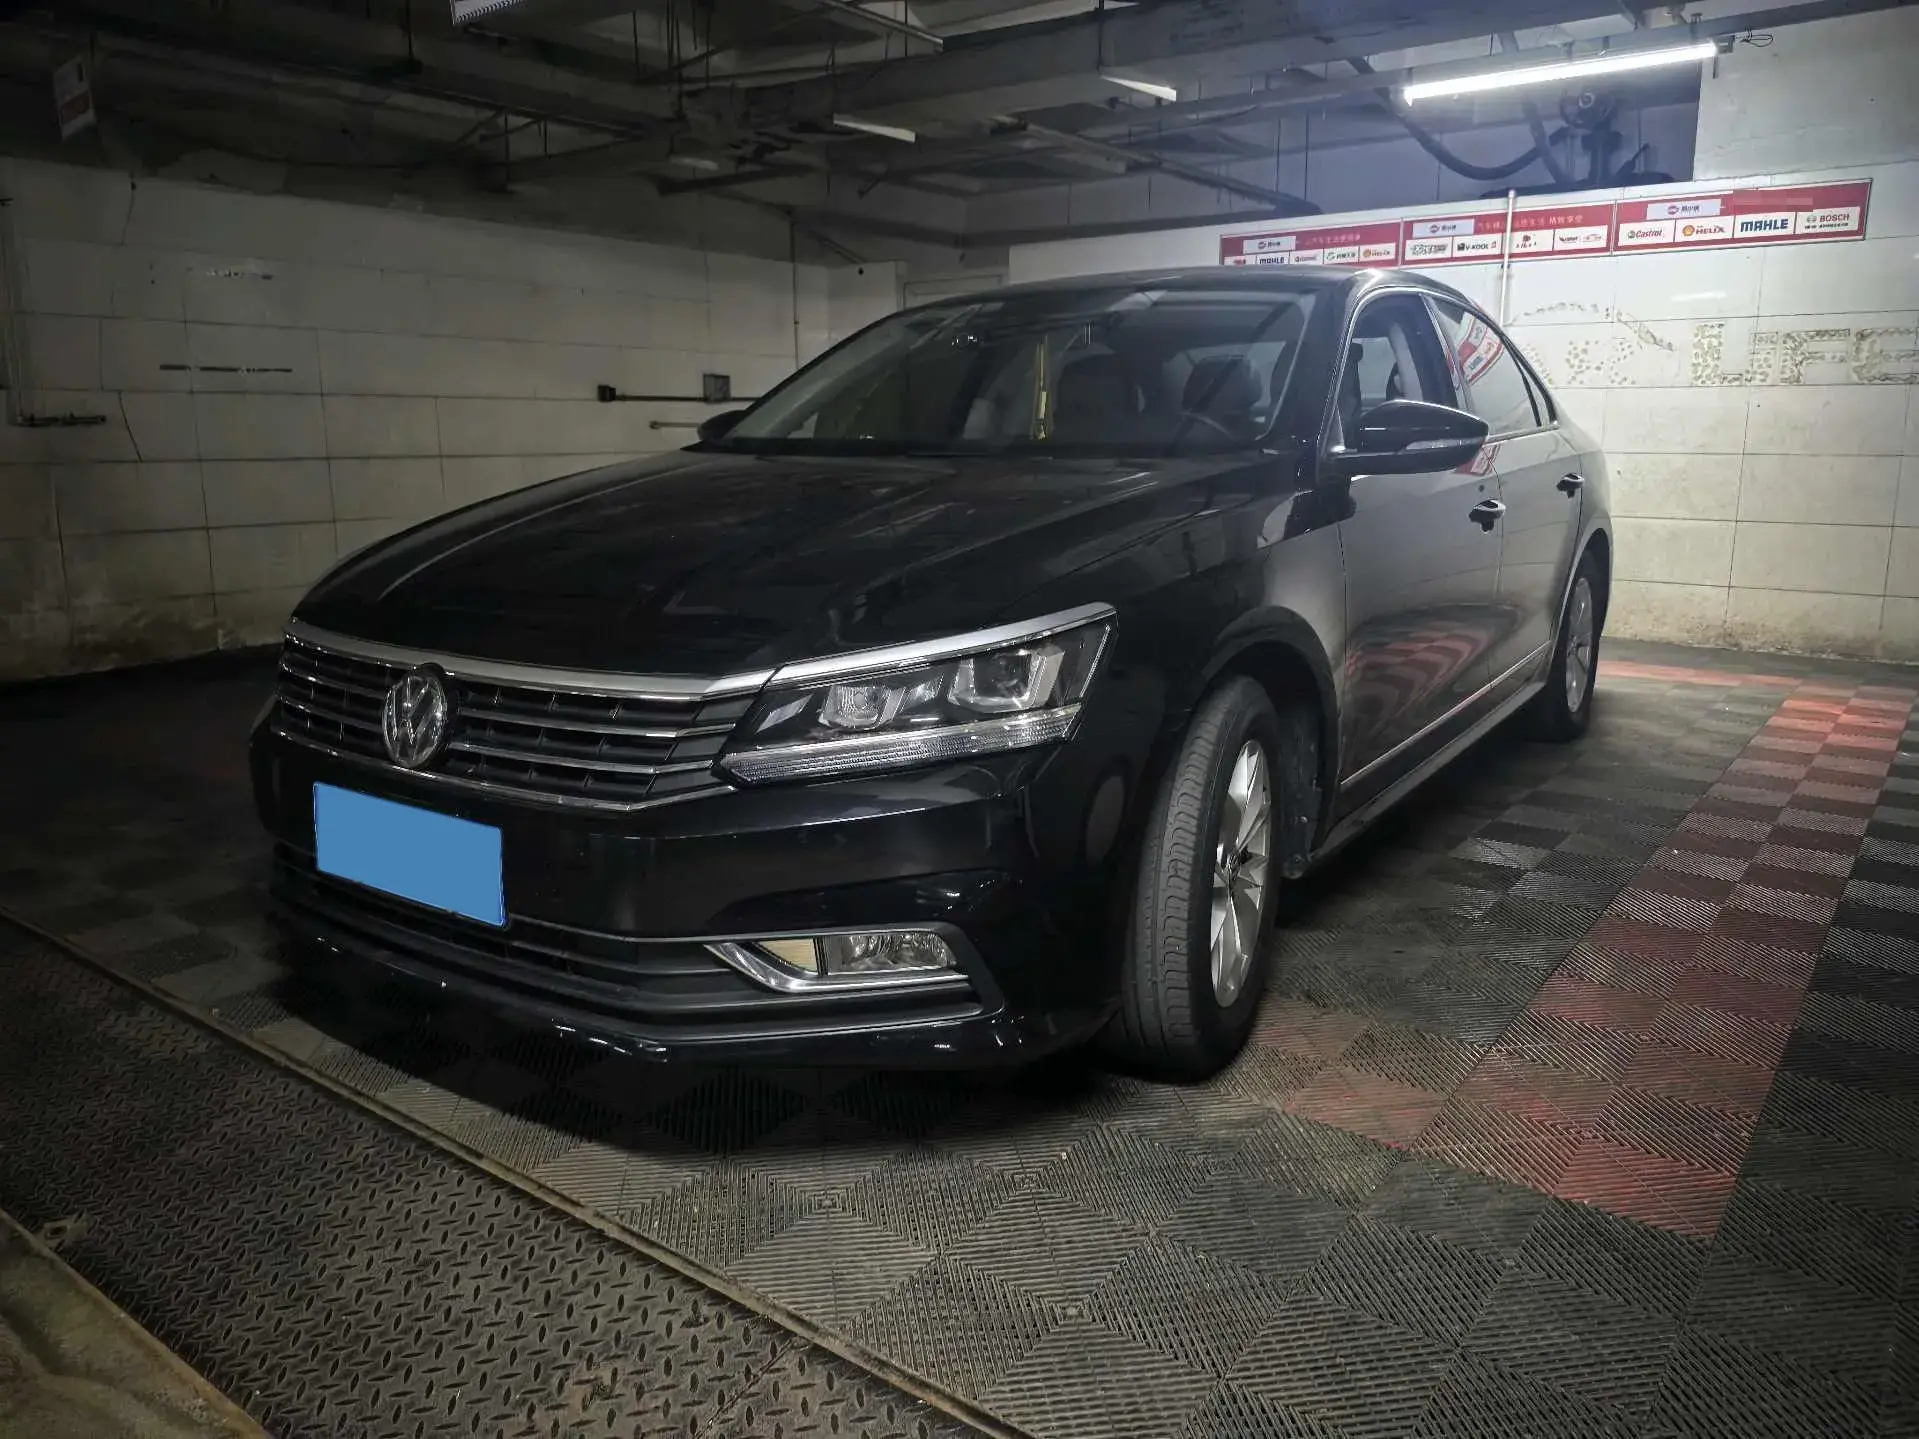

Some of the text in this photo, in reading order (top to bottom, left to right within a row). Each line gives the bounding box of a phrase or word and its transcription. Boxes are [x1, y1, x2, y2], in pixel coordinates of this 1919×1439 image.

[1820, 213, 1850, 223] BOSCH
[1696, 225, 1726, 235] HELIX
[1741, 218, 1789, 232] MAHLE
[1635, 229, 1663, 239] Castrol
